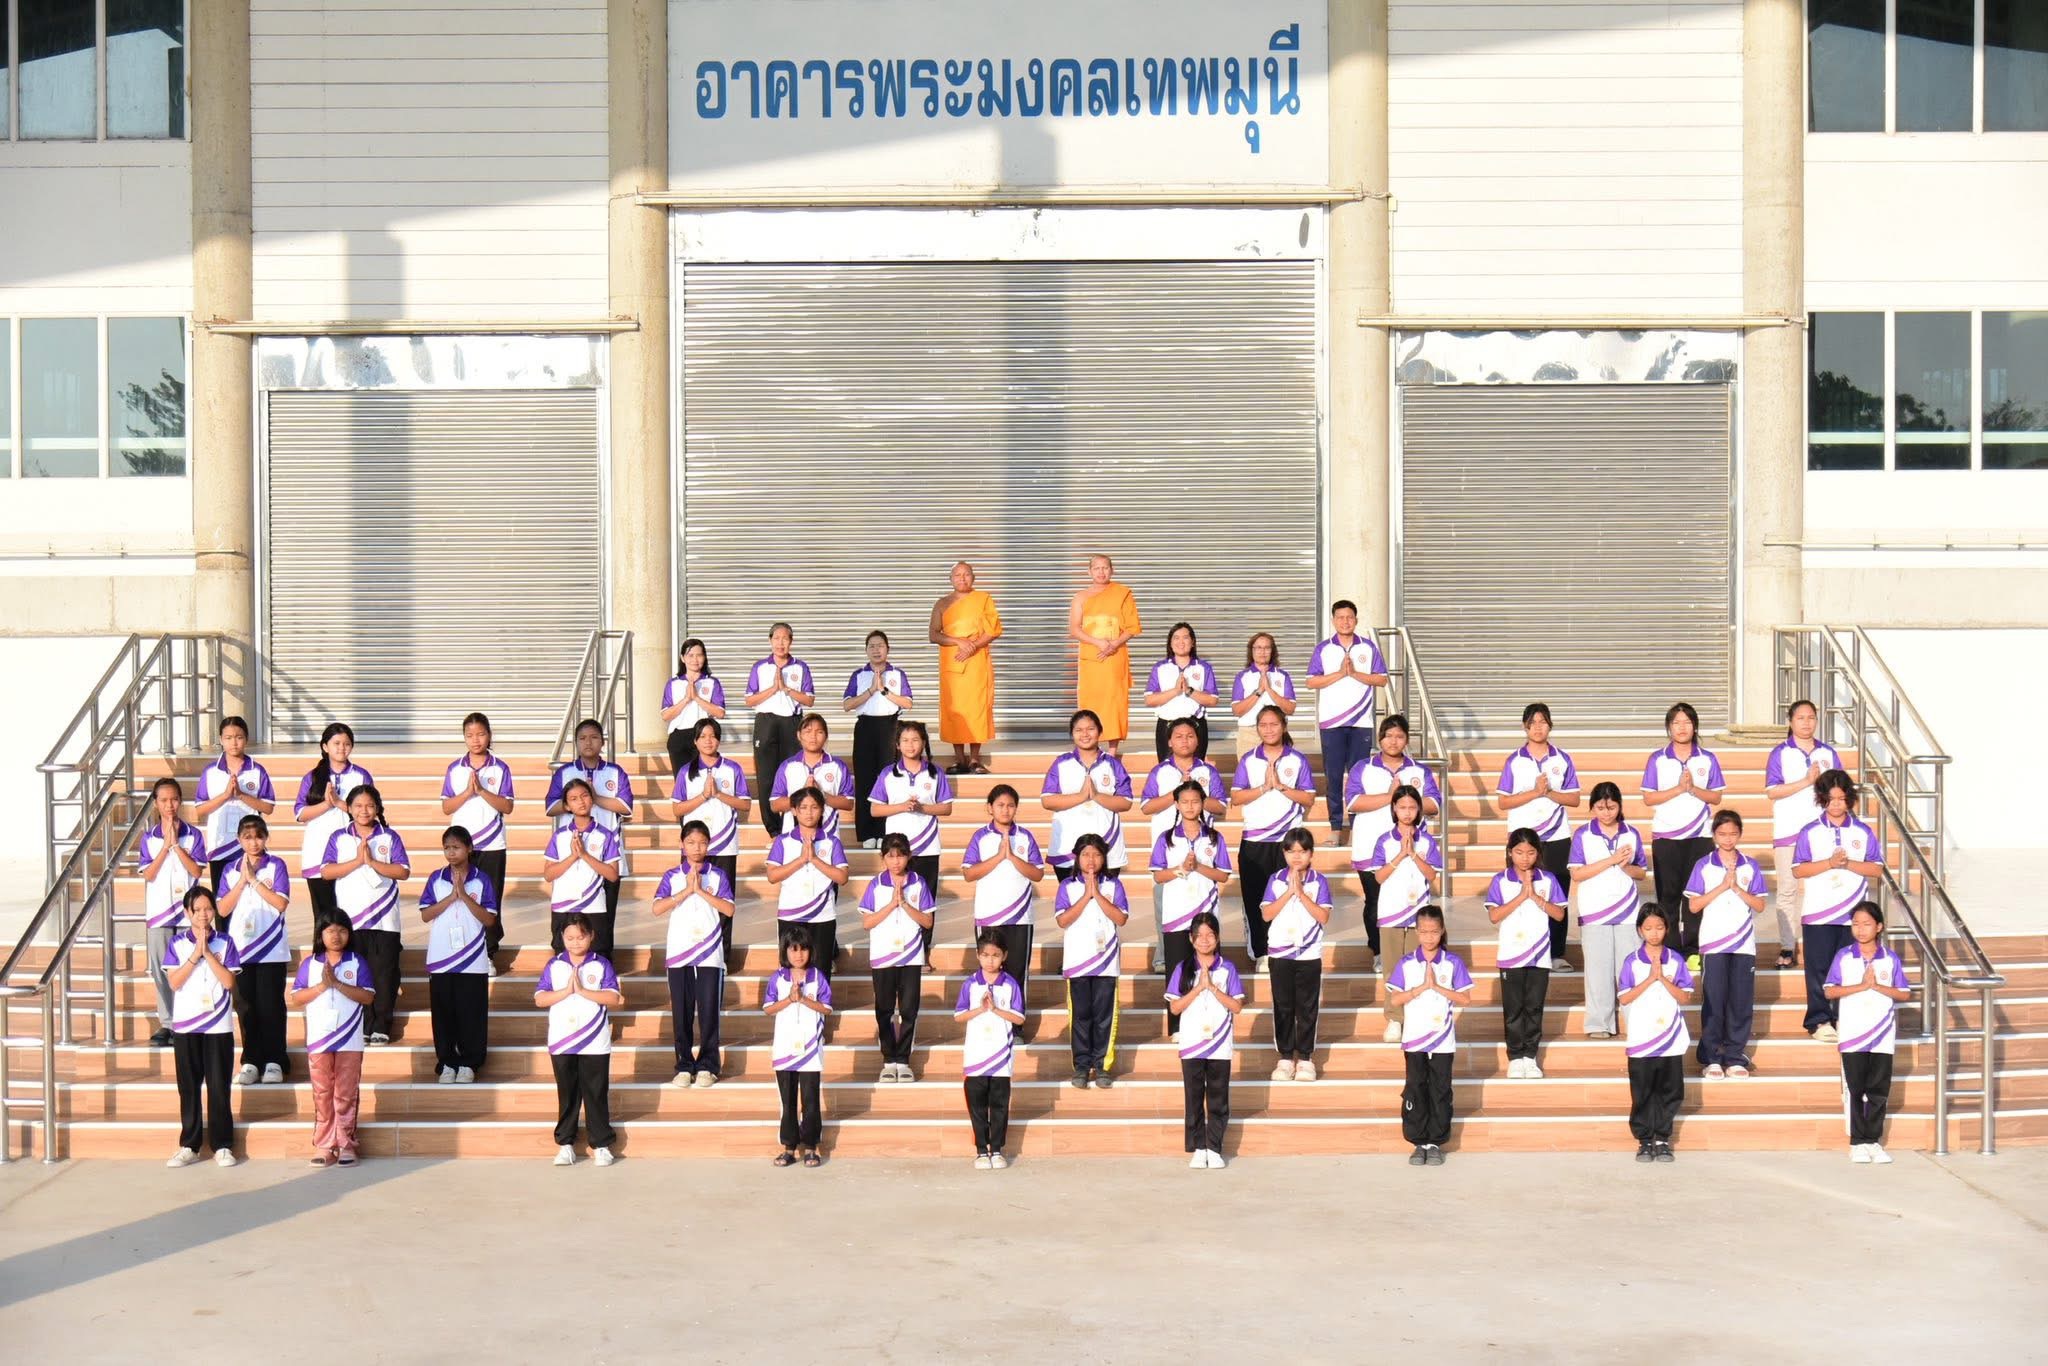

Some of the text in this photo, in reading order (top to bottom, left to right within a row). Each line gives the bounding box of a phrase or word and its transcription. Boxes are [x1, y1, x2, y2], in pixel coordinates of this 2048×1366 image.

[697, 24, 1300, 154] อาคารพระมงคลเทพมุนี
